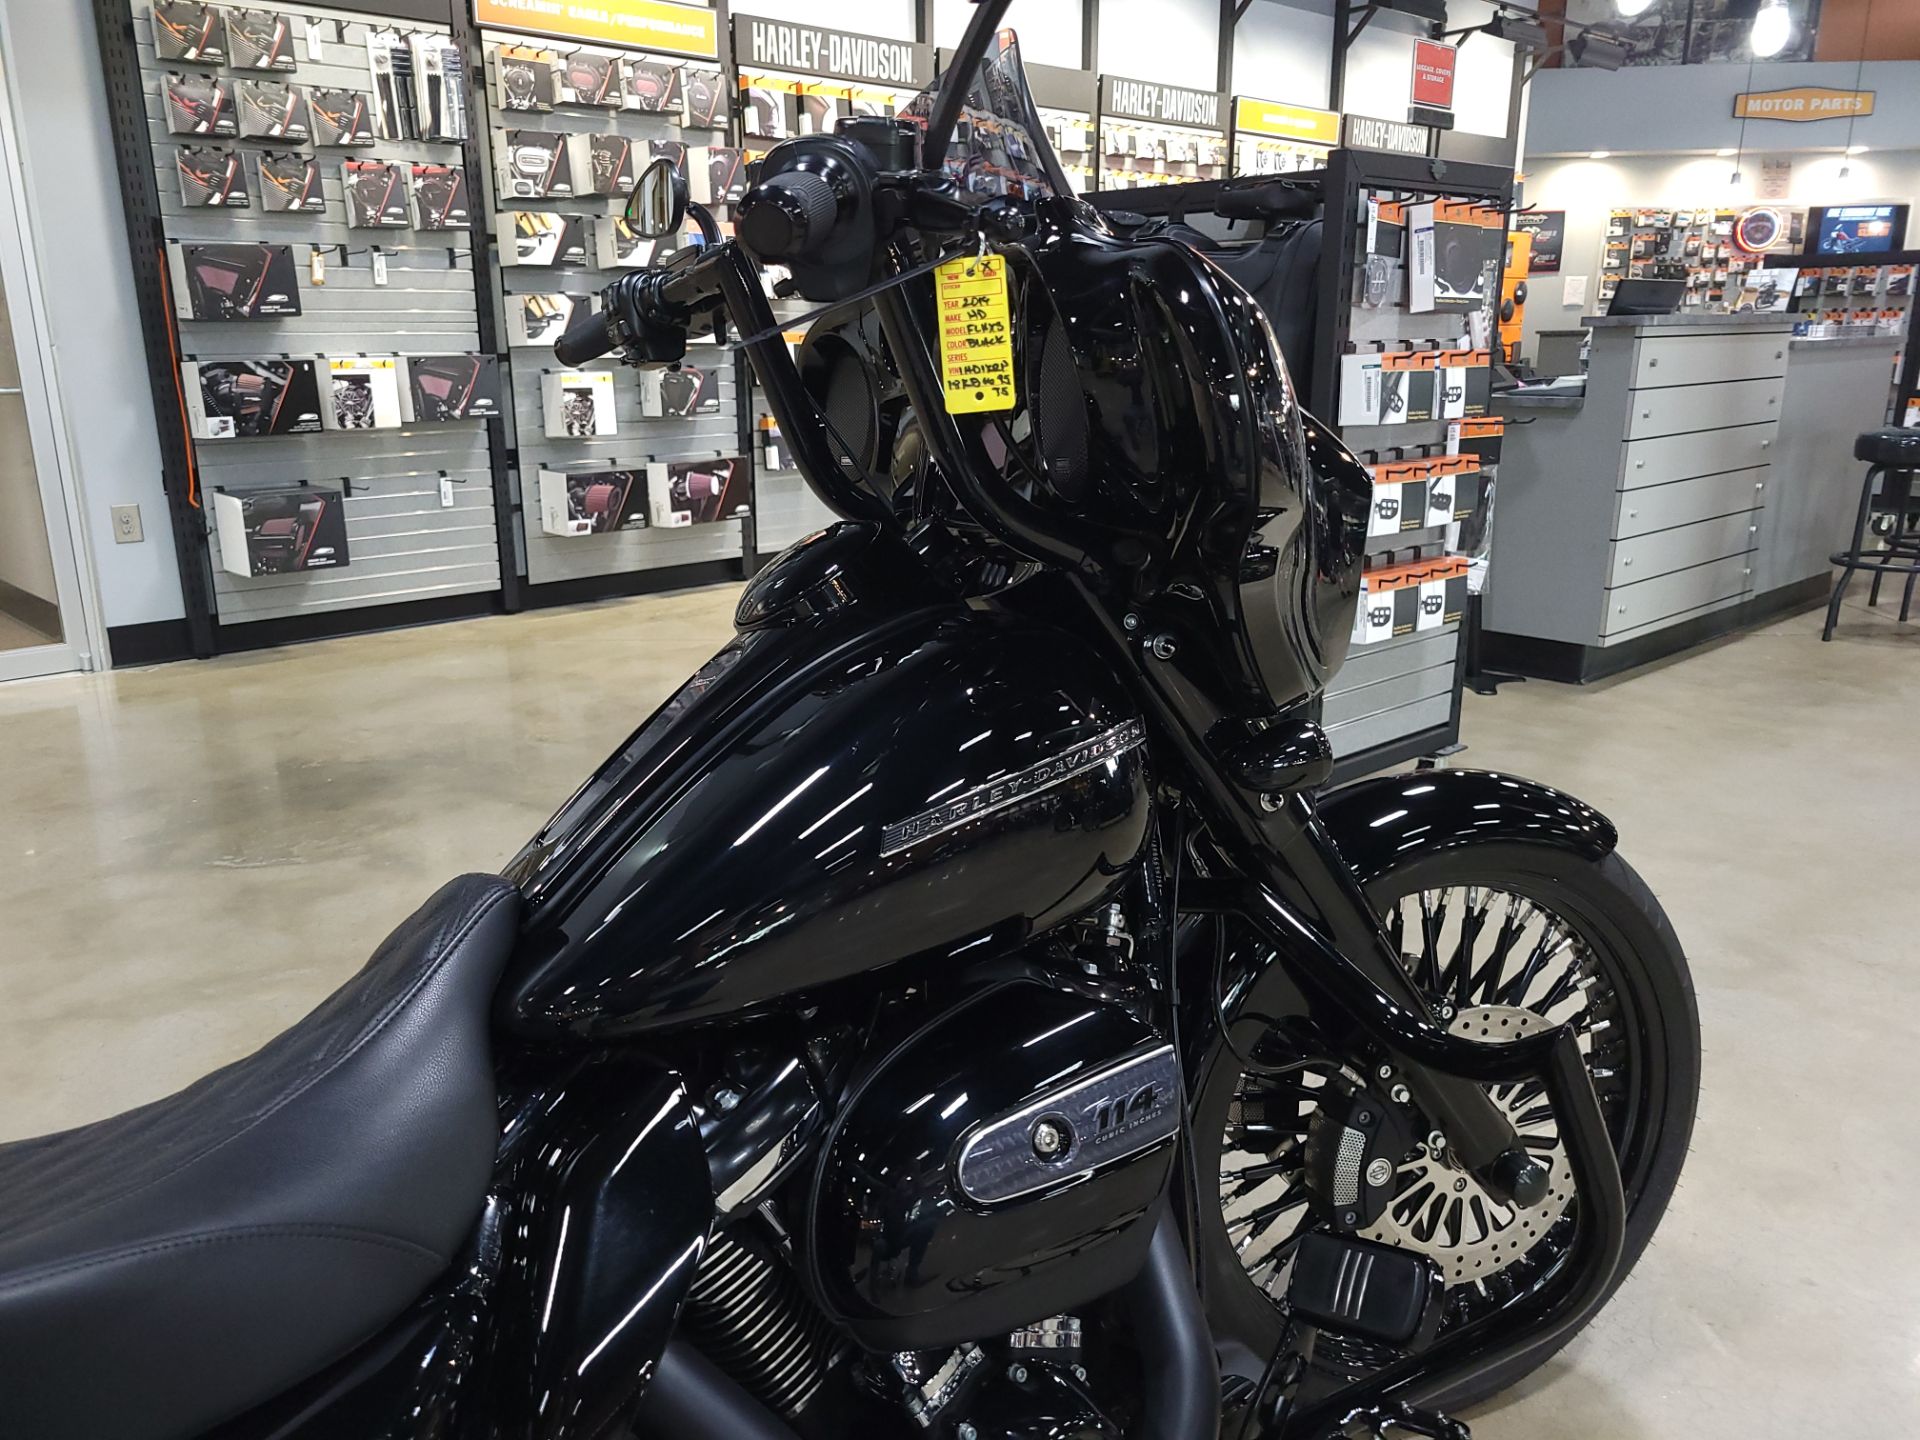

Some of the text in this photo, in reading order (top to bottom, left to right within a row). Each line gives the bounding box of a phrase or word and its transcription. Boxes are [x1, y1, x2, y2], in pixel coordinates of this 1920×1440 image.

[752, 21, 913, 84] HARLEY-DAVIDSON
[1112, 80, 1218, 126] HARLEY-DAVIDSON
[1747, 97, 1862, 112] MOTOR PARTS
[1352, 118, 1428, 155] HARLEY-DAVIDSON
[945, 314, 961, 322] MAKE
[945, 327, 966, 335] MODEL
[946, 335, 1006, 350] COLOR BLACK
[947, 353, 967, 361] SERIES
[902, 724, 1140, 840] HARLEY-DAVIDSON
[1081, 1081, 1163, 1136] 114
[1096, 1110, 1162, 1144] CUBIC INCHES
